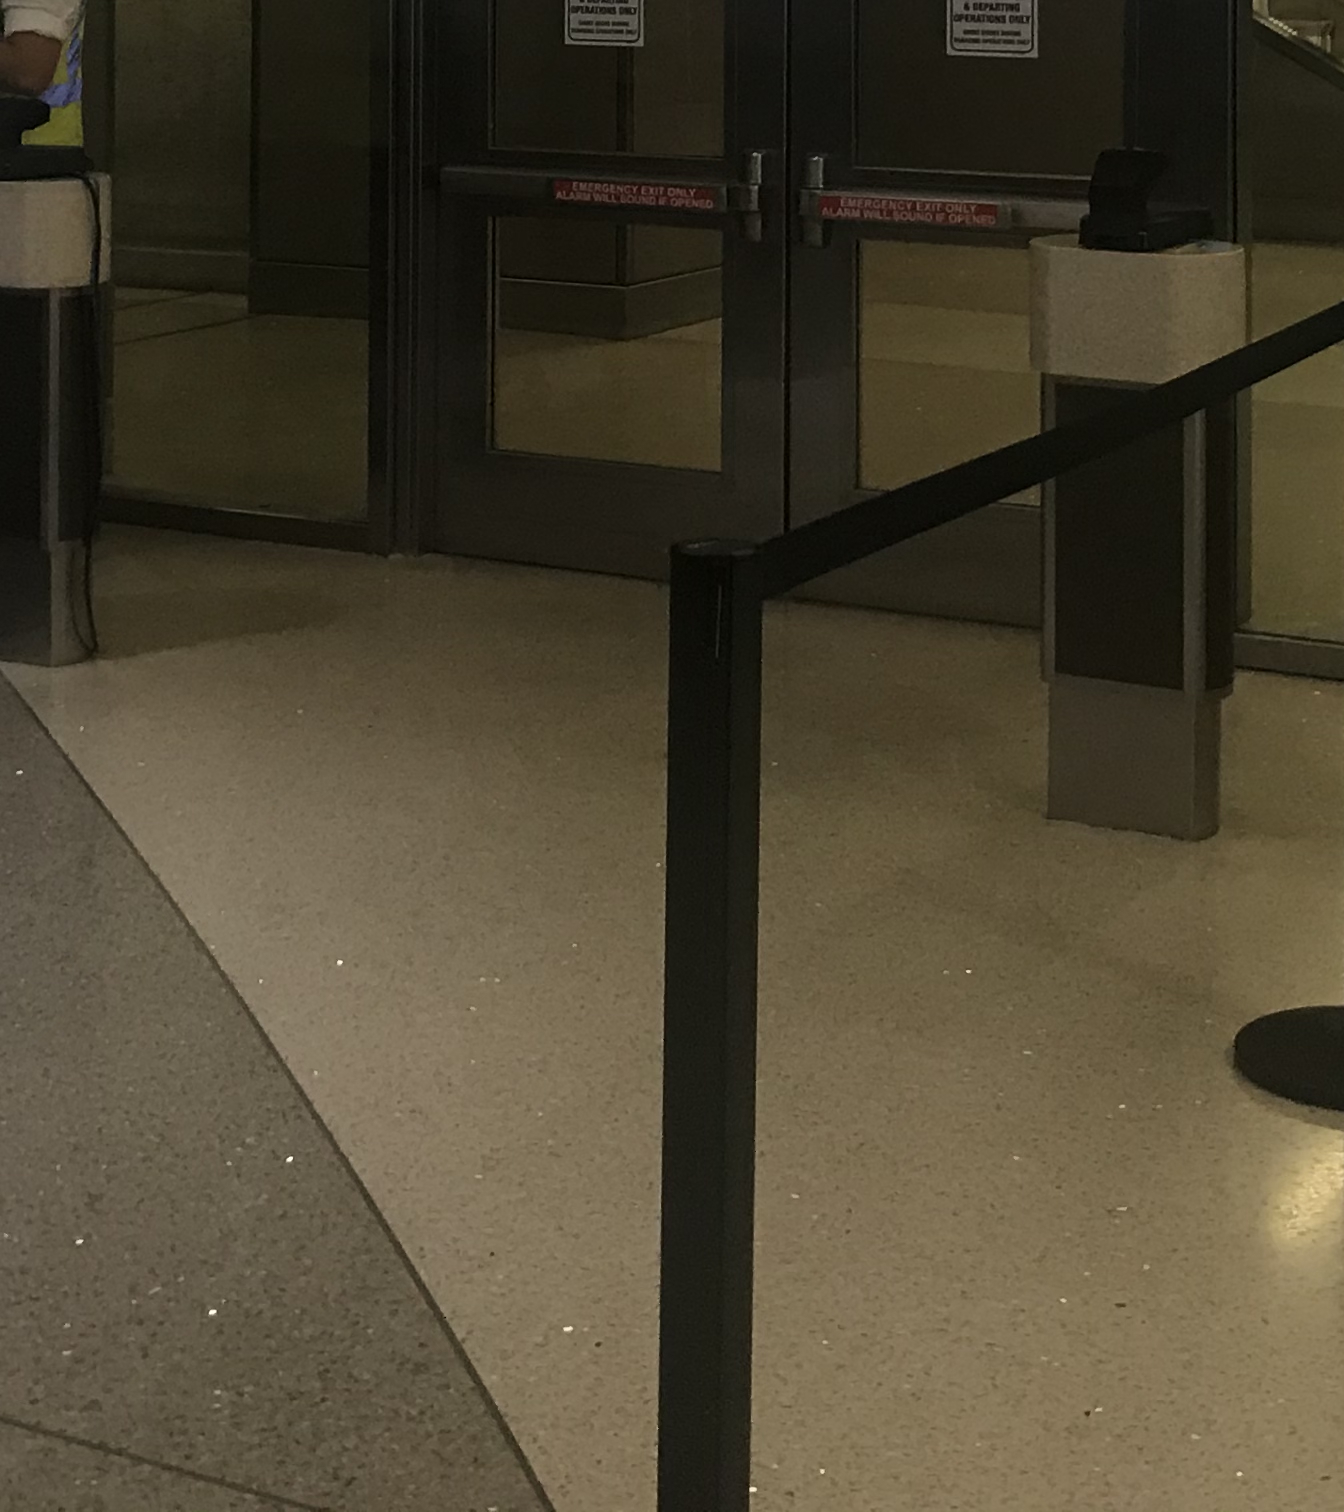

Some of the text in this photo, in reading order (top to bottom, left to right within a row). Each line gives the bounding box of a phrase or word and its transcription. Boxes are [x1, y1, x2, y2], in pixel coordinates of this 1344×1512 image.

[953, 14, 1006, 23] OPERATIONS
[572, 181, 697, 198] EMERGENCY EXIT ONLY
[555, 191, 591, 201] ALARM
[592, 193, 617, 203] WILL
[670, 197, 714, 209] OPENED
[840, 197, 977, 214] EMERGENCY EXIT ONLY
[821, 207, 996, 225] ALARM WILL SOUND IF OPENED
